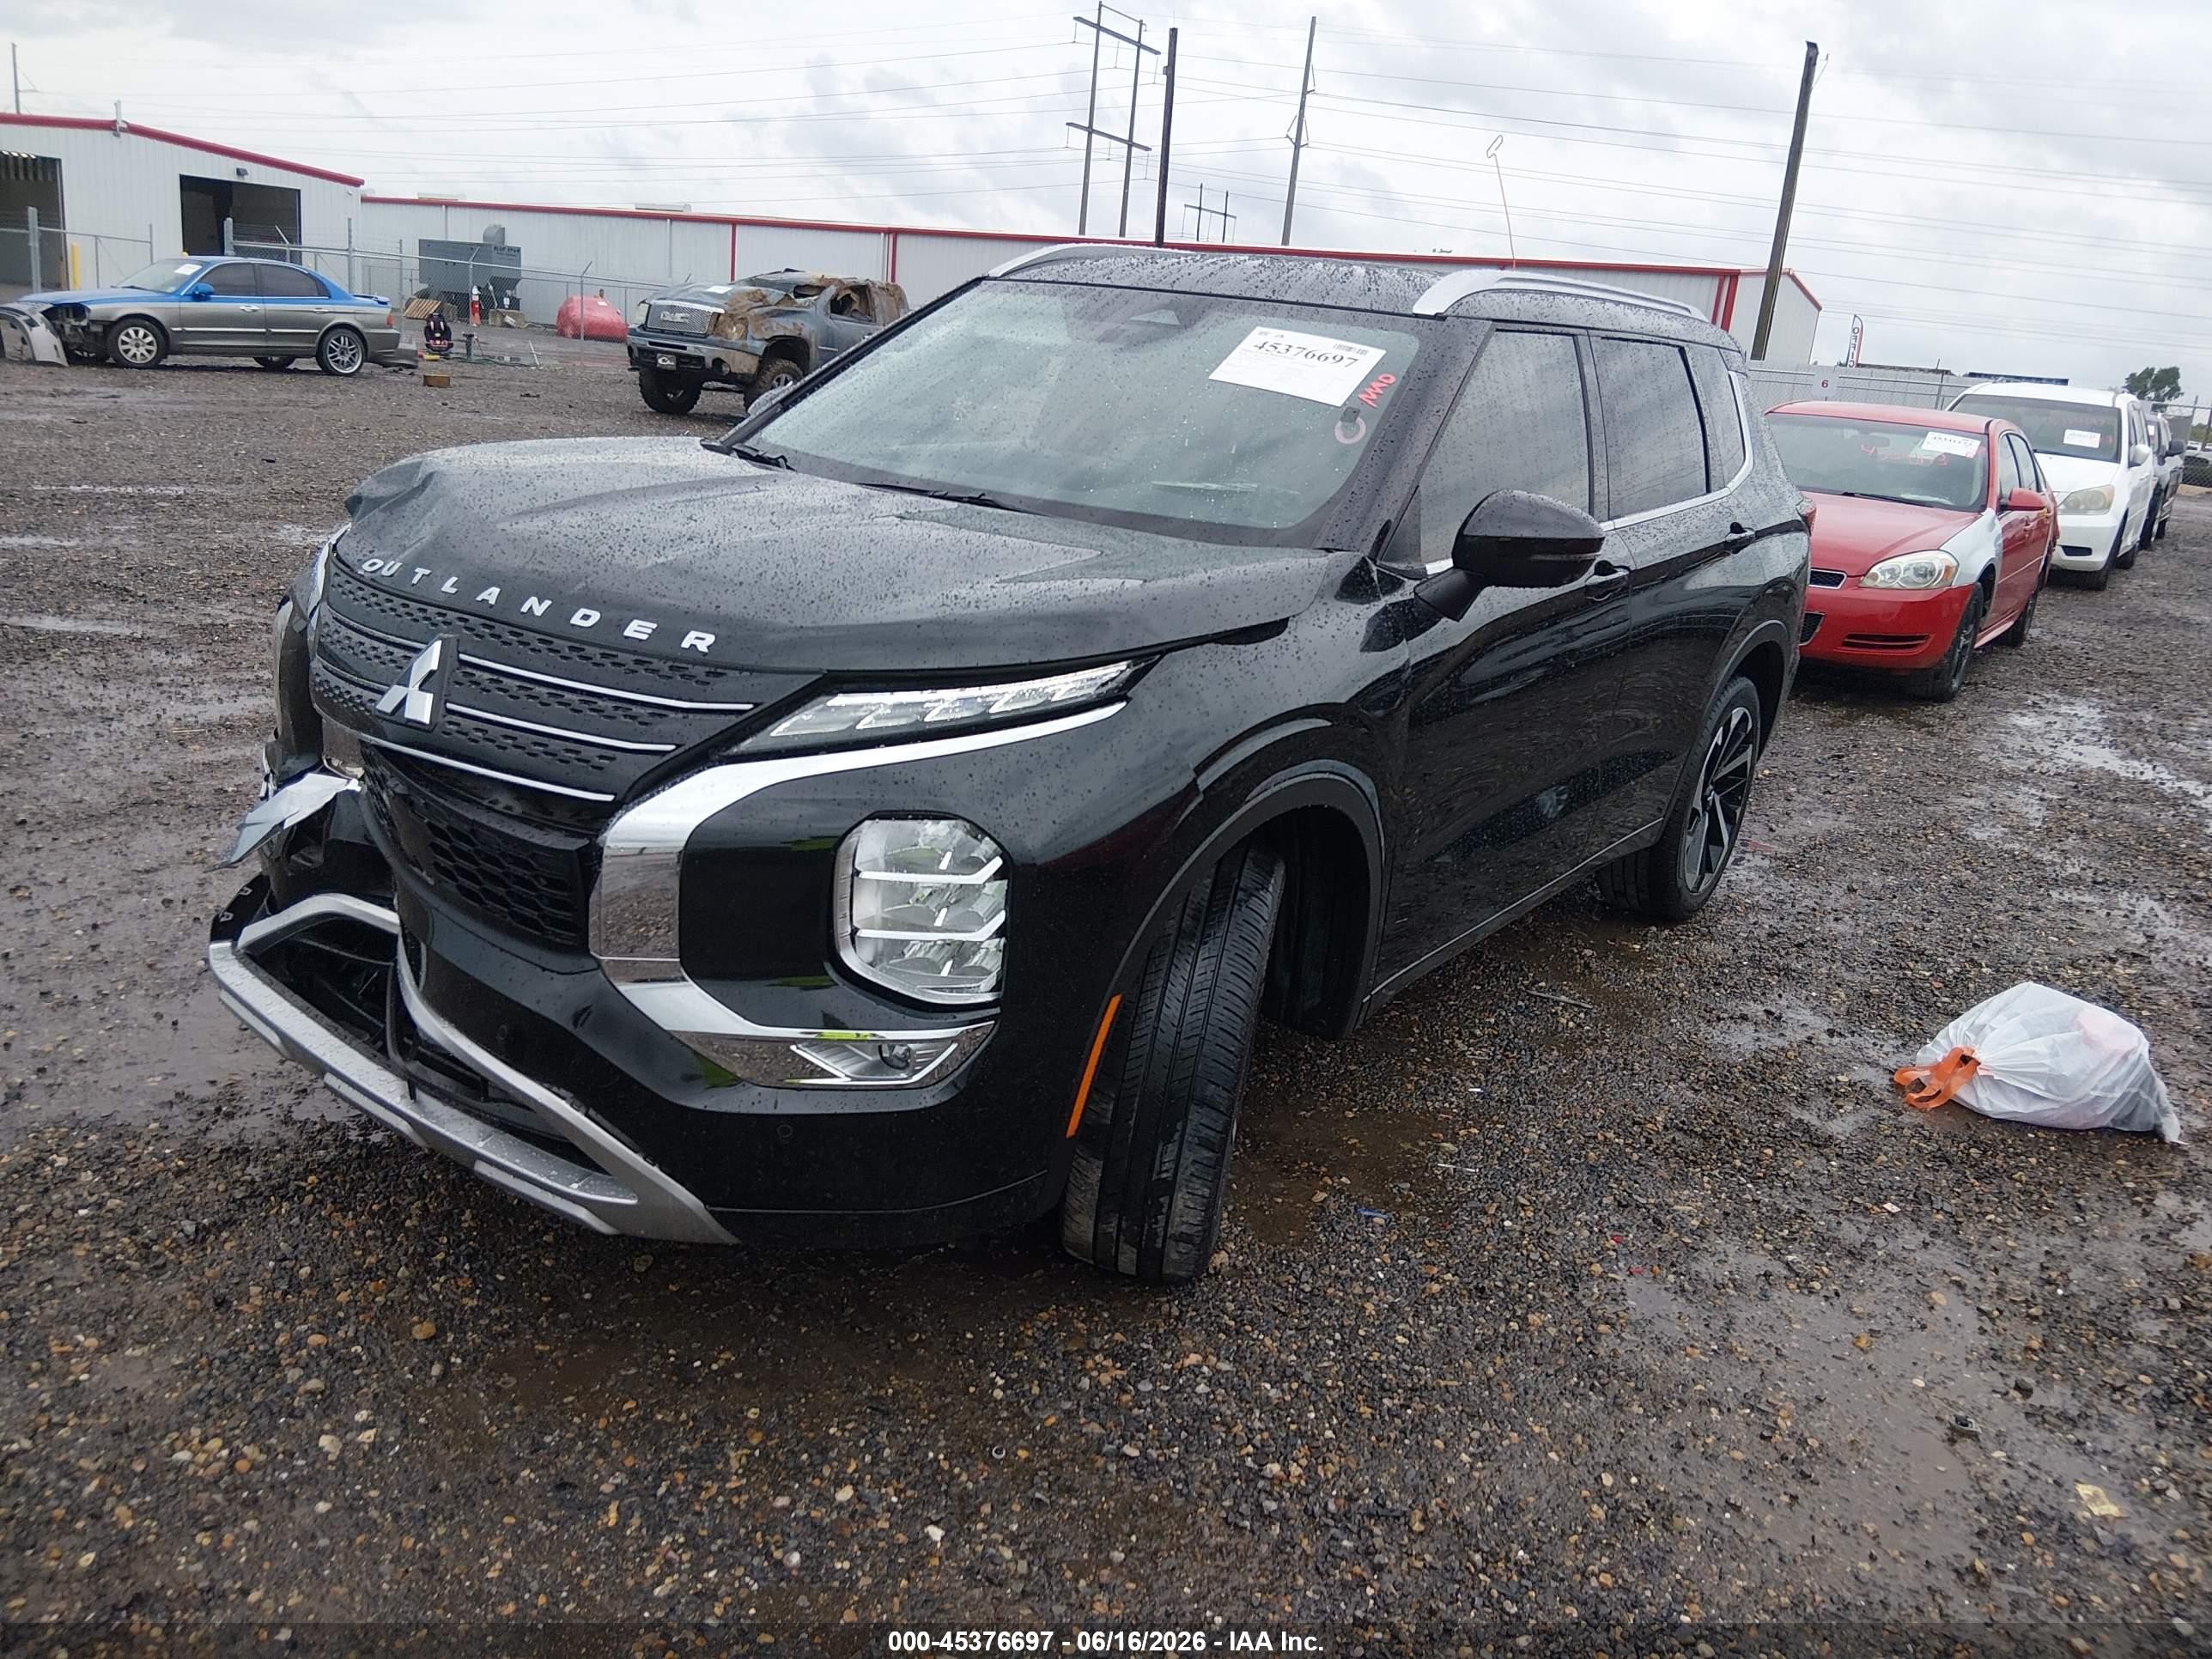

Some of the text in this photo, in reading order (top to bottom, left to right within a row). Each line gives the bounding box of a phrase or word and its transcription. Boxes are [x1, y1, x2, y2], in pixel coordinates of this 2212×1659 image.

[1253, 341, 1359, 368] 45376697
[1820, 379, 1830, 389] 6
[361, 557, 716, 653] OUTLANDER
